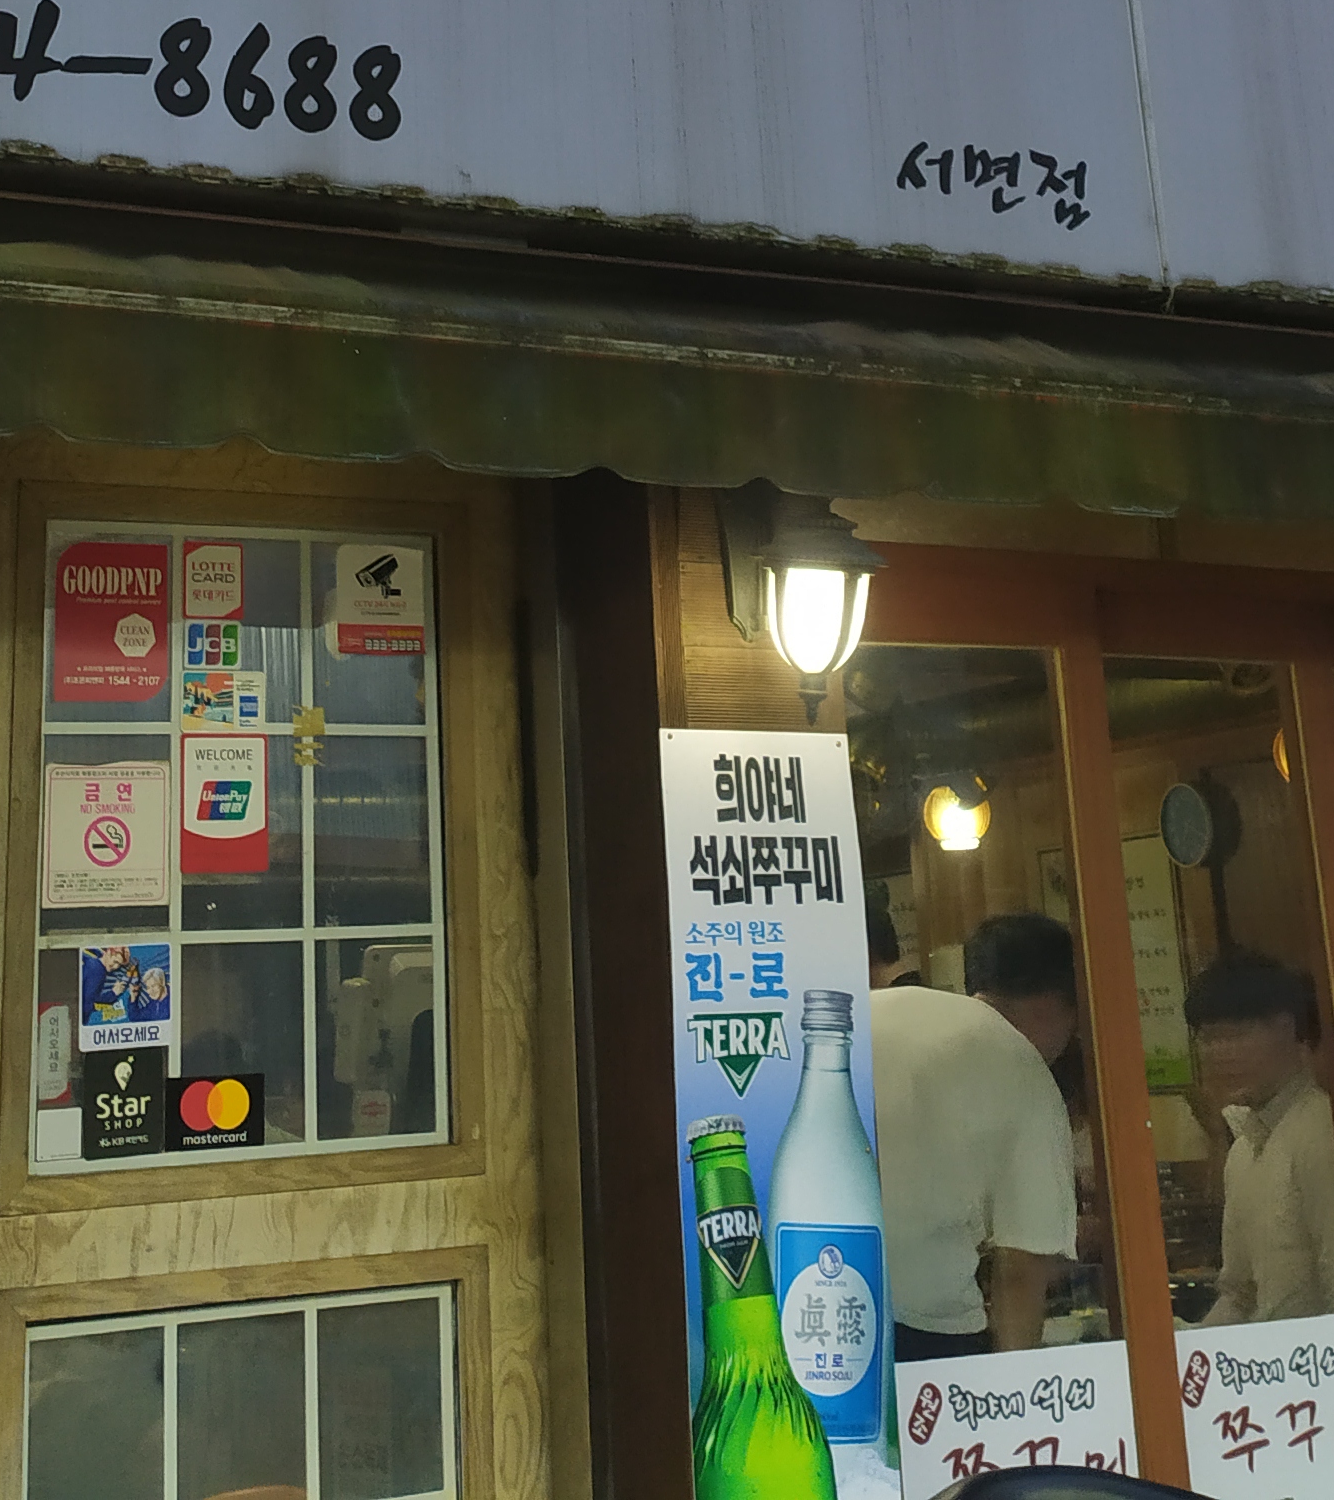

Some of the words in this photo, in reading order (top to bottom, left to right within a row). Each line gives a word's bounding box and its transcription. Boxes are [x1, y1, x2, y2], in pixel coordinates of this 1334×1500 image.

[895, 139, 1090, 231] 서면점
[191, 560, 235, 572] LOTTE
[63, 564, 162, 596] GOODPNP
[191, 572, 236, 584] CARD
[192, 589, 235, 602] 롯데카드
[120, 626, 150, 636] CLEAN
[122, 637, 148, 648] ZONE
[186, 636, 237, 653] JCB
[194, 748, 253, 761] WELCOME
[202, 789, 249, 802] UnionPay
[714, 753, 807, 824] 희야네
[80, 803, 93, 814] NO
[95, 803, 136, 815] SMOKING
[689, 835, 845, 905] 석쇠쭈꾸미
[685, 921, 743, 946] 소주의
[748, 921, 786, 945] 원조
[93, 1025, 160, 1046] 어서오세요
[687, 1016, 791, 1064] TERRA
[96, 1093, 151, 1120] Star
[104, 1118, 143, 1131] SHOP
[182, 1131, 248, 1146] mastercard
[699, 1209, 760, 1249] TERRA
[804, 1370, 831, 1381] JINRO
[1216, 1351, 1285, 1395] 희야네
[948, 1383, 1025, 1431] 희야네
[1030, 1375, 1095, 1423] 석쇠
